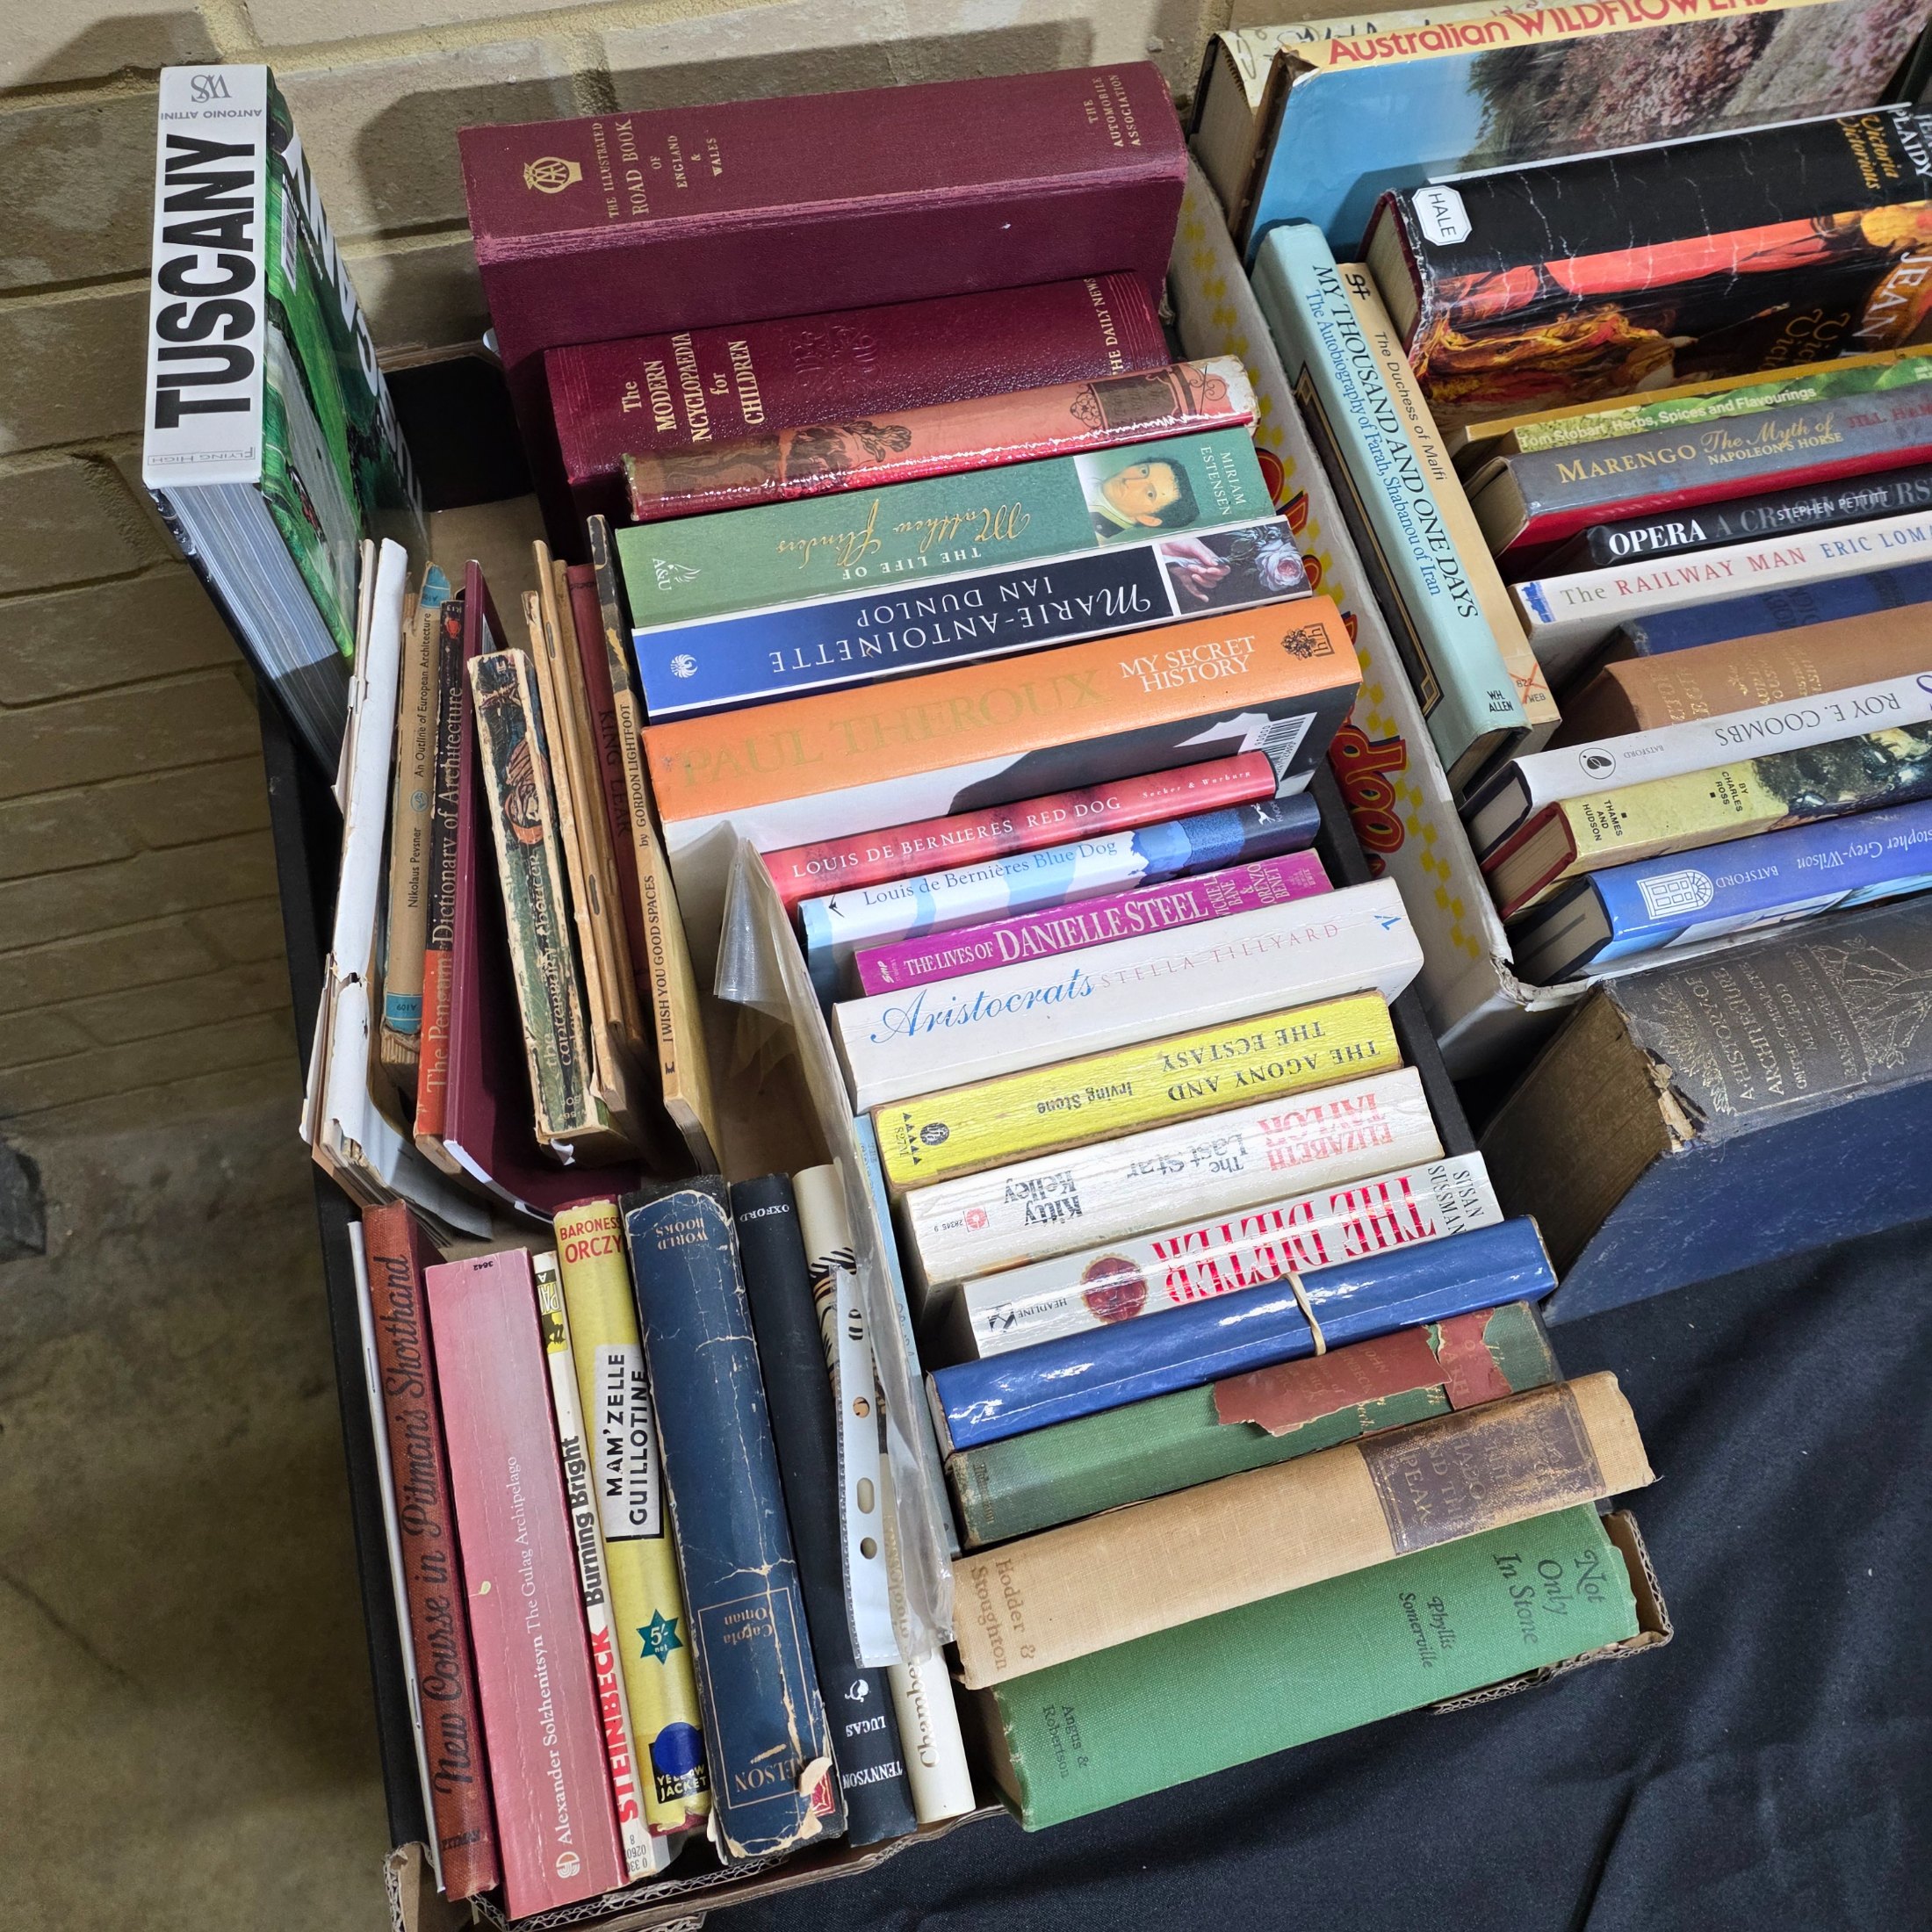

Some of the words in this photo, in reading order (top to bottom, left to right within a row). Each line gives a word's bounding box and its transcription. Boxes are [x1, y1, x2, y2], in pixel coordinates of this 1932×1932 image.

[1329, 21, 1510, 64] Australian
[161, 111, 198, 120] ATTINI
[203, 109, 263, 119] ANTONIO
[1083, 99, 1099, 124] THE
[1092, 77, 1124, 148] AUTOMOBILE
[1108, 75, 1141, 147] ASSOCIATION
[592, 122, 615, 192] ILLUSTRATED
[615, 119, 638, 162] BOOK
[706, 137, 723, 177] WALES
[1836, 117, 1881, 191] Victorious
[1860, 113, 1900, 179] Victoria
[650, 155, 662, 169] OF
[667, 135, 688, 189] ENGLAND
[606, 197, 619, 219] THE
[626, 169, 649, 215] ROAD
[1427, 192, 1458, 237] HALE
[153, 133, 256, 429] TUSCANY
[1851, 251, 1931, 341] JEAN
[1306, 289, 1325, 318] The
[1099, 311, 1119, 346] DAILY
[710, 372, 731, 396] for
[728, 341, 765, 425] CHILDREN
[1317, 321, 1363, 415] Autobiography
[622, 381, 642, 413] The
[644, 360, 677, 433] MODERN
[1374, 331, 1392, 357] The
[1387, 361, 1419, 422] Duchess
[1413, 425, 1431, 440] of
[1422, 443, 1449, 481] Malfi
[1657, 404, 1707, 424] Spices
[1707, 399, 1735, 415] and
[1735, 387, 1818, 410] Flavourings
[1313, 264, 1344, 300] MY
[1331, 303, 1400, 435] THOUSAND
[1386, 437, 1424, 494] AND
[1412, 498, 1451, 551] ONE
[1435, 555, 1479, 618] DAYS
[1358, 417, 1373, 431] of
[1798, 432, 1845, 450] HORSE
[1554, 444, 1697, 484] MARENGO
[1700, 429, 1744, 454] The
[1747, 417, 1810, 452] Myth
[1200, 446, 1231, 516] ESTENSEN
[1221, 451, 1246, 506] MIRIAM
[1382, 475, 1420, 545] Shabanou
[1776, 501, 1835, 522] STEPHEN
[941, 547, 982, 565] THE
[1412, 546, 1431, 562] of
[1607, 518, 1708, 557] OPERA
[1714, 513, 1733, 538] A
[652, 558, 672, 591] A&U
[842, 566, 869, 580] OF
[882, 553, 928, 573] LIFE
[1419, 563, 1442, 598] Iran
[1560, 584, 1609, 608] The
[1614, 559, 1734, 597] RAILWAY
[1746, 546, 1808, 573] MAN
[1820, 536, 1874, 559] ERIC
[856, 589, 983, 628] DUNLOP
[1000, 577, 1052, 601] IAN
[420, 613, 432, 668] Architecture
[769, 583, 1151, 674] MARIE-ANTOINETTE
[1118, 653, 1160, 680] MY
[1164, 635, 1256, 667] SECRET
[1140, 660, 1250, 693] HISTORY
[417, 670, 431, 712] European
[1488, 701, 1515, 714] ALLEN
[1852, 691, 1902, 718] ROY
[417, 711, 427, 727] of
[681, 726, 824, 789] PAUL
[828, 668, 1107, 757] THEROUX
[1713, 708, 1821, 748] COOMBS
[1824, 703, 1846, 723] E.
[415, 724, 427, 760] Outline
[620, 703, 639, 774] LIGHTFOOT
[1623, 743, 1666, 761] BATSFORD
[415, 759, 425, 778] An
[1738, 782, 1749, 796] BY
[630, 775, 647, 827] GORDON
[1714, 781, 1731, 806] ROSS
[1721, 770, 1743, 813] CHARLES
[792, 853, 859, 878] LOUIS
[866, 845, 894, 863] DE
[900, 820, 1013, 855] BERNIERES
[1026, 807, 1067, 828] RED
[1076, 797, 1121, 818] DOG
[1582, 803, 1604, 843] HUDSON
[1597, 810, 1610, 830] AND
[1604, 798, 1625, 838] THAMES
[408, 826, 422, 862] Pevsner
[638, 833, 649, 848] by
[1796, 840, 1884, 870] Grey-Wilson
[407, 862, 421, 908] Nikolaus
[862, 883, 915, 906] Louis
[919, 877, 942, 894] de
[946, 859, 1031, 889] Bernières
[1033, 849, 1076, 869] Blue
[1079, 840, 1119, 861] Dog
[1715, 864, 1781, 890] BATSFORD
[642, 875, 660, 923] SPACES
[646, 924, 663, 965] GOOD
[904, 954, 936, 977] THE
[934, 946, 976, 972] LIVES
[975, 941, 995, 963] OF
[993, 902, 1126, 962] DANIELLE
[1122, 890, 1210, 934] STEEL
[651, 966, 667, 998] YOU
[870, 970, 1096, 1044] Aristocrats
[1101, 956, 1196, 989] STELLA
[1214, 923, 1340, 964] TILLYARD
[655, 998, 674, 1034] WISH
[1275, 1020, 1326, 1042] THE
[1161, 1033, 1263, 1072] ECSTASY
[1234, 1054, 1317, 1088] AGONY
[1330, 1039, 1381, 1065] THE
[1036, 1093, 1081, 1114] Stone
[1168, 1075, 1221, 1103] AND
[1209, 1156, 1244, 1173] The
[1004, 1169, 1078, 1205] Kelley
[1427, 1164, 1467, 1235] SUSSMAN
[1453, 1169, 1484, 1219] SUSAN
[560, 1216, 623, 1241] BARONESS
[739, 1204, 790, 1222] OXFORD
[1024, 1194, 1084, 1227] Kitty
[1330, 1175, 1438, 1258] THE
[565, 1234, 624, 1264] ORCZY
[373, 1254, 424, 1399] Shorthand
[1018, 1298, 1069, 1319] HEADLINE
[602, 1353, 626, 1498] MAM'ZELLE
[628, 1369, 648, 1526] GUILLOTINE
[400, 1409, 438, 1543] Pitman's
[559, 1435, 588, 1509] Bright
[506, 1455, 530, 1547] Archipelago
[520, 1547, 537, 1597] Gulag
[577, 1510, 606, 1607] Burning
[1574, 1549, 1607, 1604] Not
[996, 1558, 1026, 1633] Hodder
[1493, 1553, 1519, 1578] In
[1507, 1584, 1539, 1646] Stone
[1538, 1559, 1568, 1617] Only
[527, 1598, 542, 1634] The
[723, 1606, 769, 1626] Oman
[971, 1565, 1008, 1670] Stoughton
[1399, 1591, 1433, 1669] Somerville
[1427, 1596, 1453, 1649] Phyllis
[422, 1598, 462, 1703] Course
[532, 1633, 559, 1748] Solzhenitsyn
[591, 1625, 639, 1825] STEINBECK
[845, 1715, 887, 1738] LUCAS
[1042, 1704, 1071, 1780] Robertson
[1062, 1705, 1083, 1752] Angus
[435, 1712, 470, 1794] New
[659, 1777, 709, 1802] JACKET
[842, 1760, 904, 1790] TENNYSON
[549, 1748, 573, 1846] Alexander
